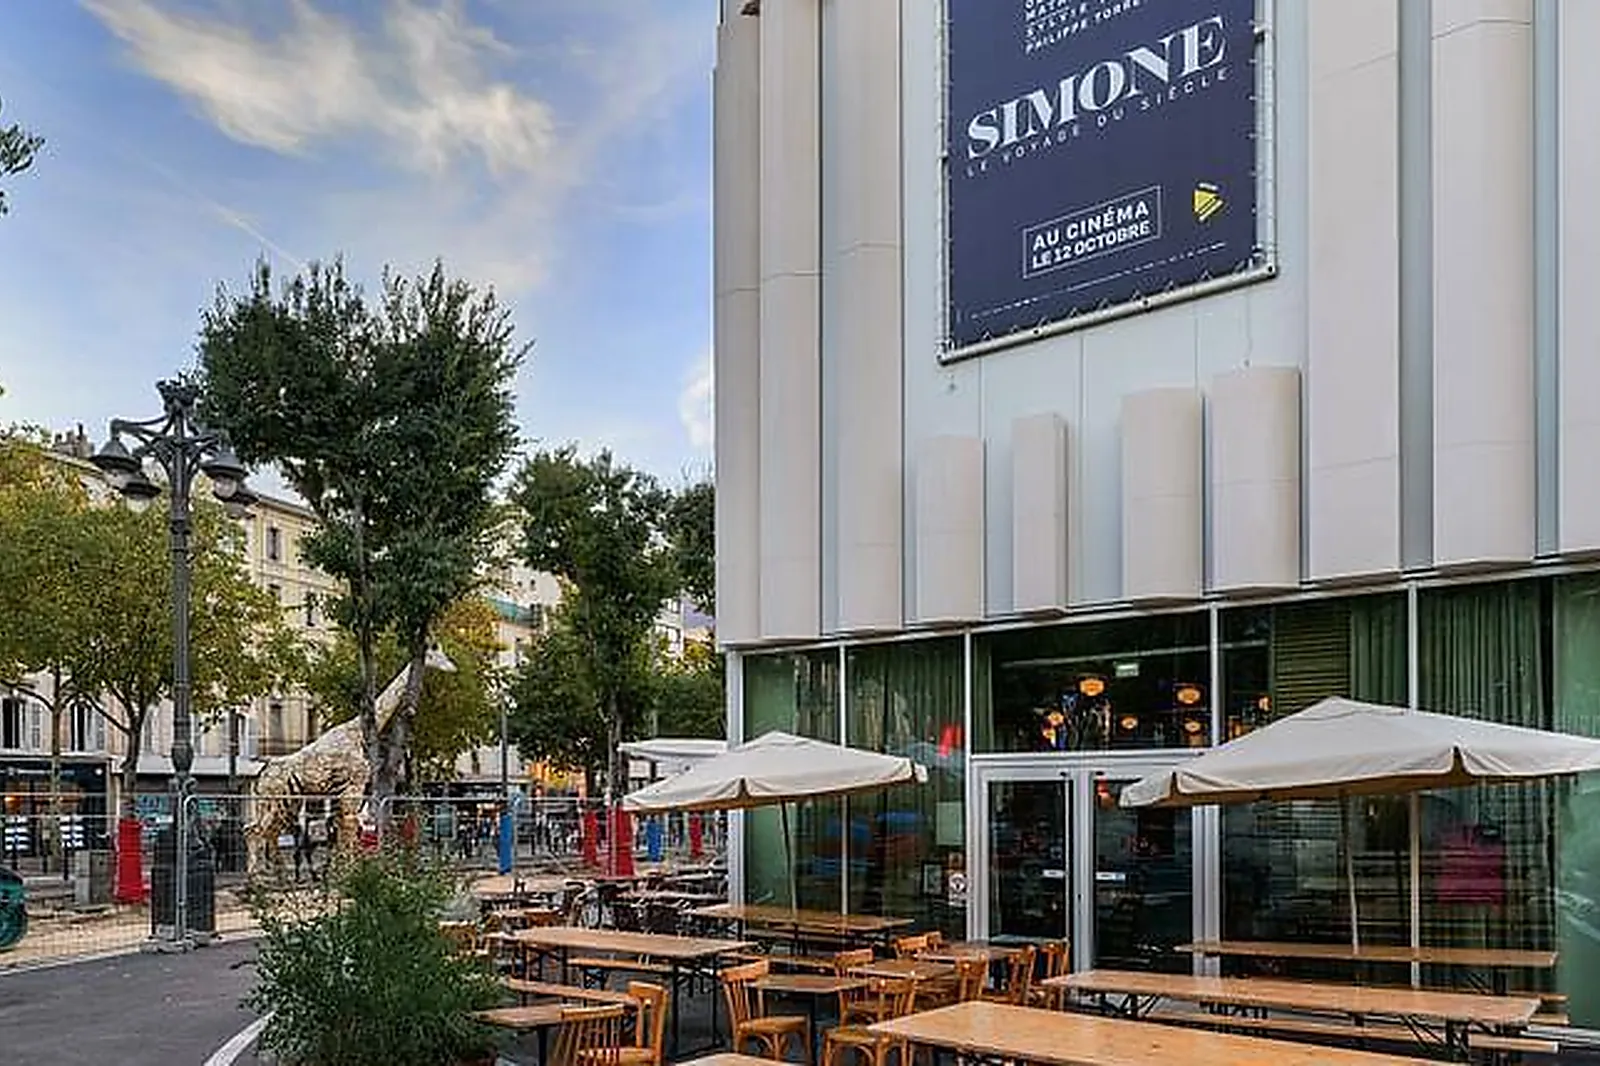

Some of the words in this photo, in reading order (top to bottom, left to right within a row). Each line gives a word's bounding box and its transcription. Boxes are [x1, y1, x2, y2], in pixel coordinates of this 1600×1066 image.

[1026, 19, 1087, 54] PHILIPPE
[967, 15, 1227, 160] SIMONE
[1097, 106, 1125, 128] DU
[1033, 228, 1060, 251] AU
[1066, 201, 1150, 240] CINÉMA
[1033, 250, 1052, 269] LE
[1054, 245, 1072, 263] 12
[1074, 220, 1151, 256] OCTOBRE
